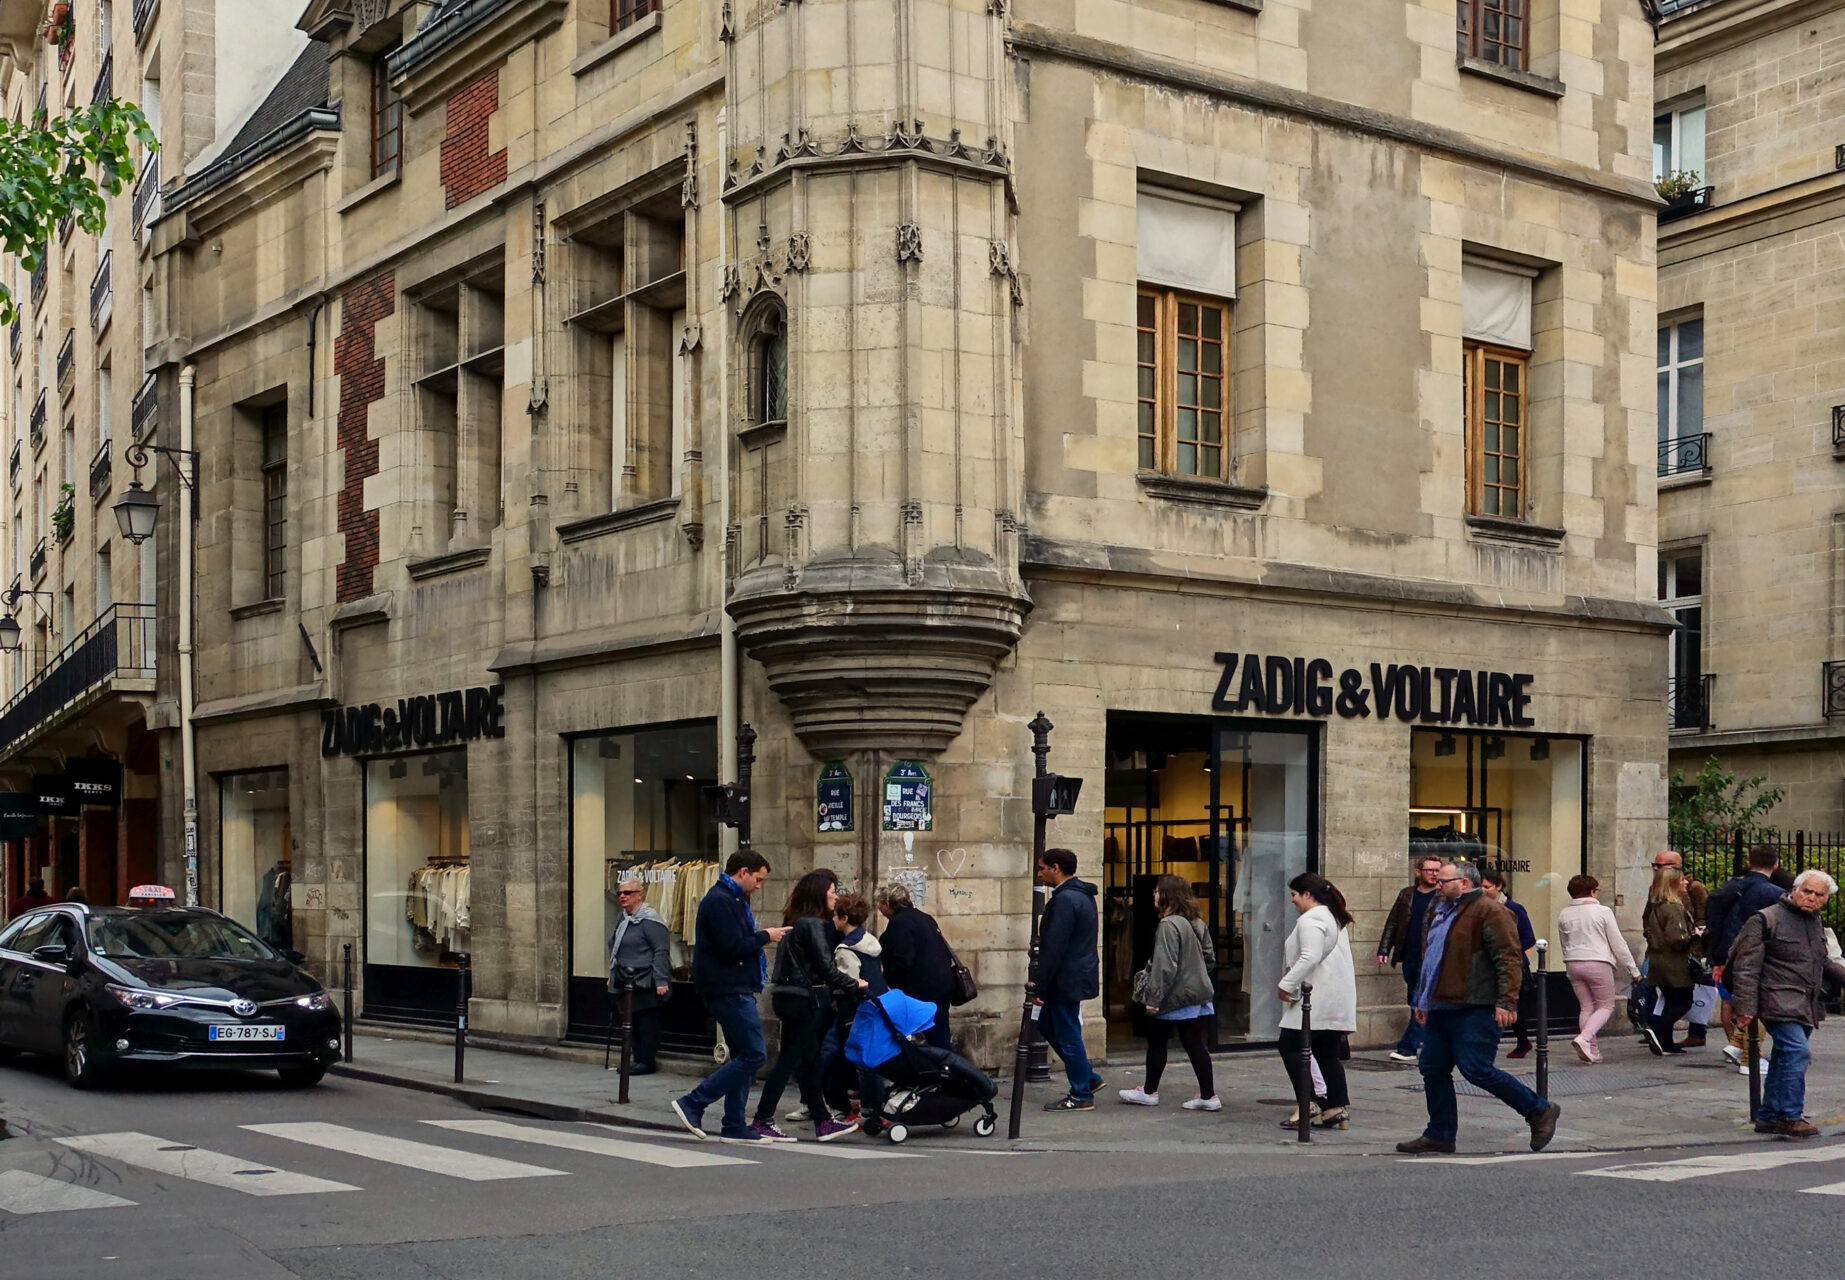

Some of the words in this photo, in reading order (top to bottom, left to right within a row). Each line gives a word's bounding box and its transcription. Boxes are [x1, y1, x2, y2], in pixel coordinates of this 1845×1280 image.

[73, 782, 112, 791] IKKS
[39, 795, 65, 803] IKK
[892, 812, 924, 820] BOURGEOIS
[1494, 860, 1531, 872] VOLTAIRE
[644, 869, 676, 883] VOLTAIRE
[217, 1027, 277, 1038] EG-787-SJ
